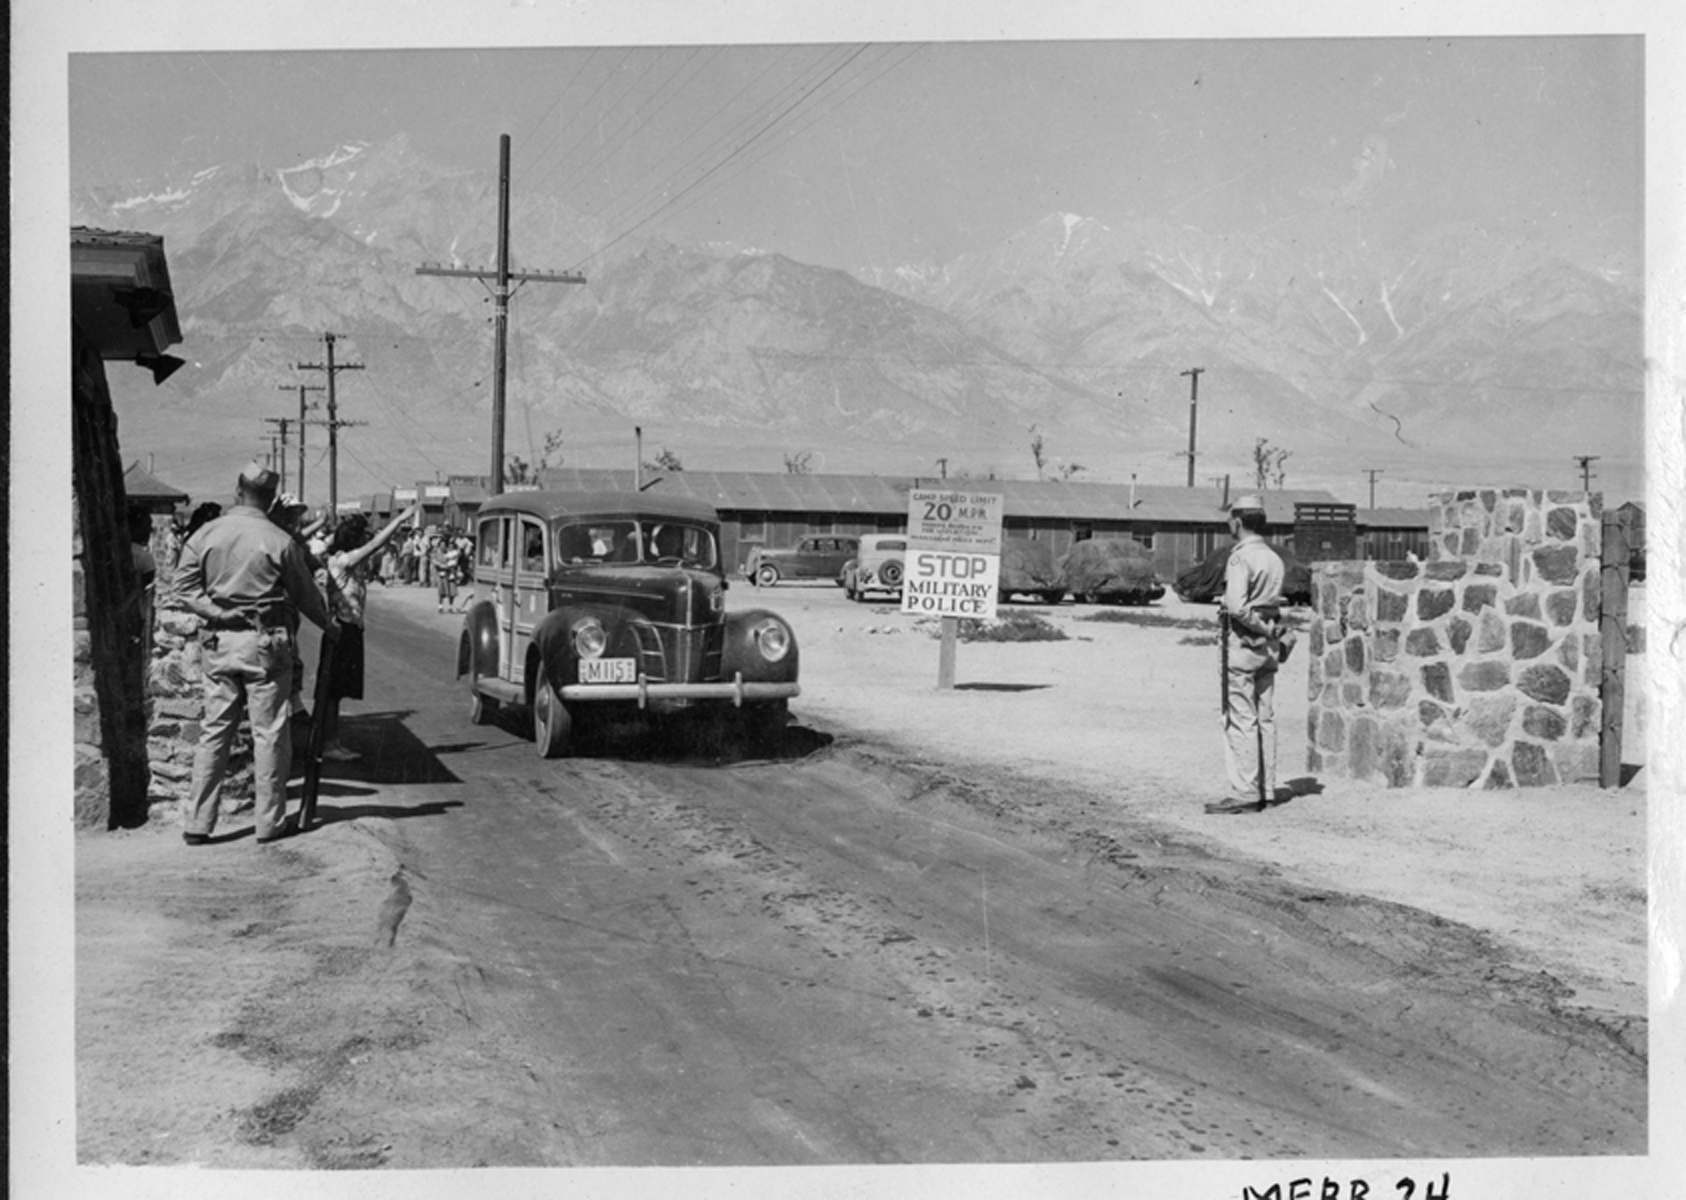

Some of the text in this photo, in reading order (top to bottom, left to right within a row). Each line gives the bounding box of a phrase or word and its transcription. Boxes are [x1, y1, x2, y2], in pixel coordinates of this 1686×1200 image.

[913, 492, 997, 505] CAMP SPEED LIMIT
[923, 501, 952, 521] 20
[917, 554, 987, 579] STOP
[908, 580, 992, 598] MILITARY
[907, 595, 987, 614] POLICE
[588, 661, 625, 680] M115
